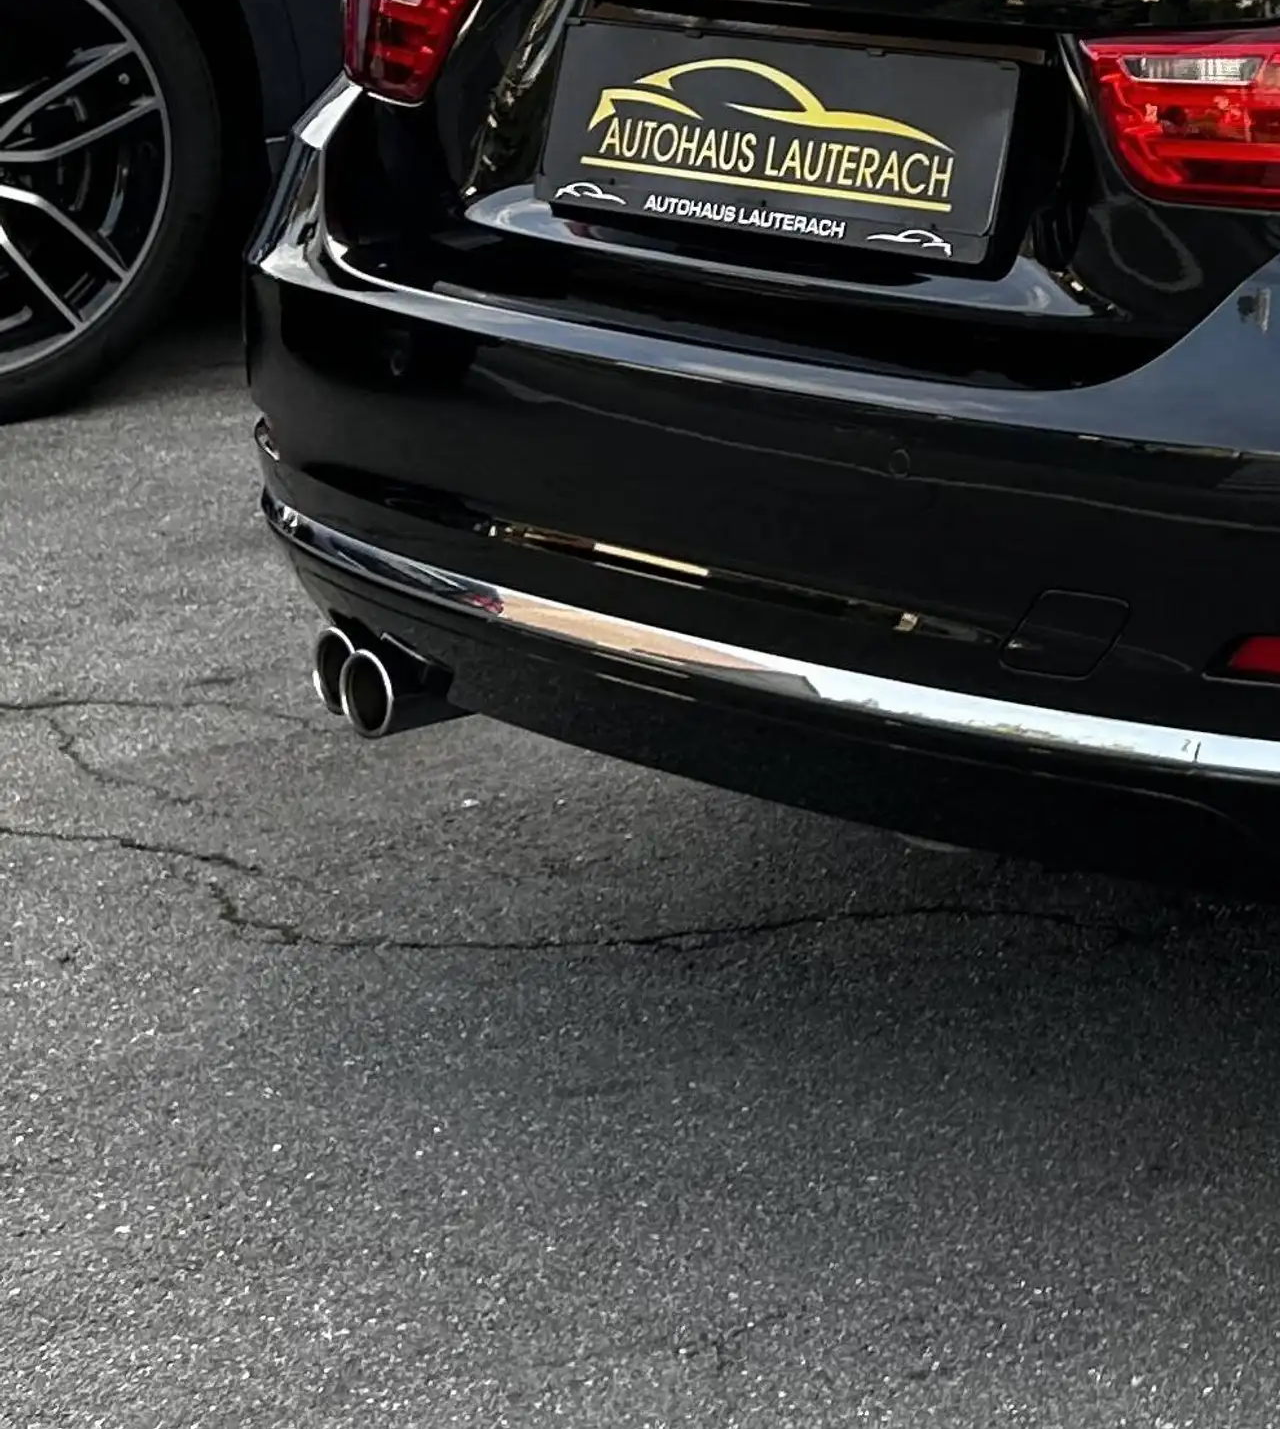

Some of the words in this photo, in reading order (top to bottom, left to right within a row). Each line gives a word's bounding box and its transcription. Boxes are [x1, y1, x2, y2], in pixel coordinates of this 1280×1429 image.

[599, 116, 757, 173] AUTOHAUS
[763, 135, 955, 199] LAUTERACH
[643, 194, 737, 223] AUTOHAUS
[737, 207, 846, 239] LAUTERACH
